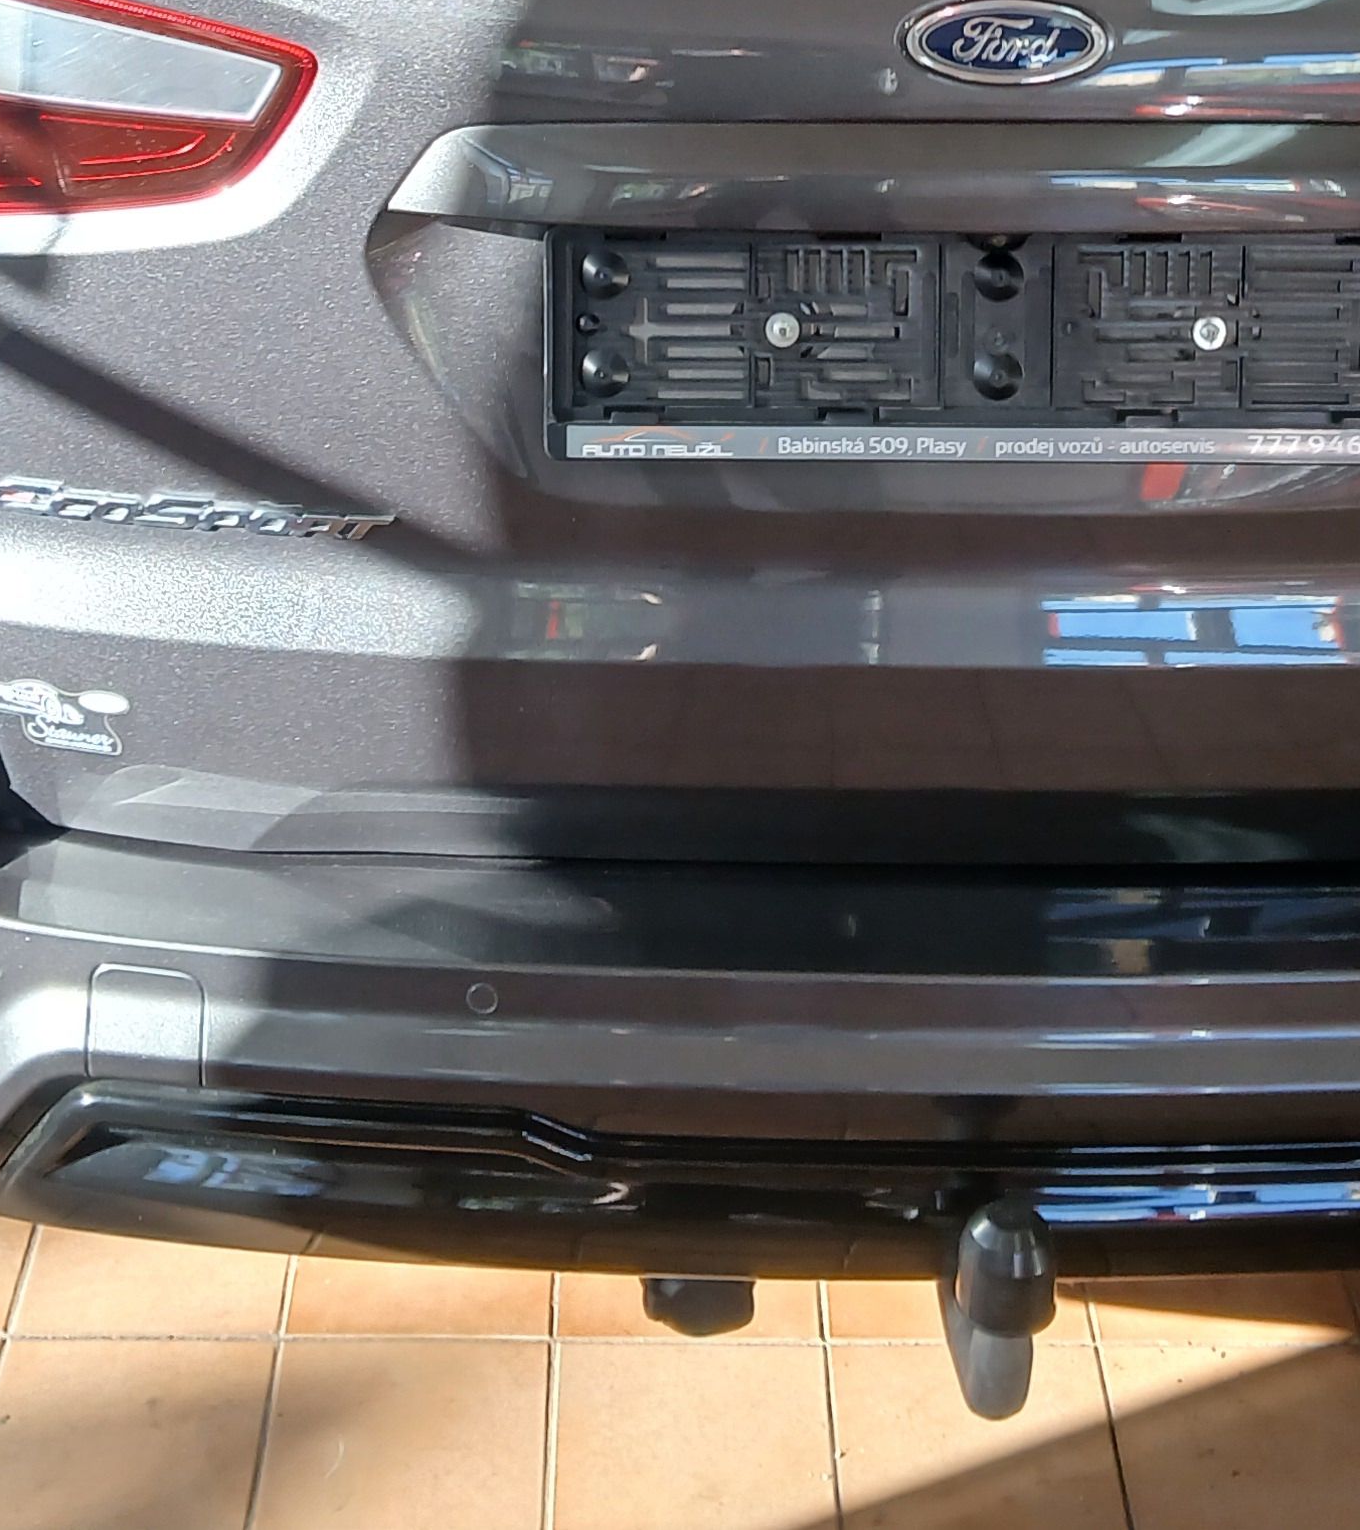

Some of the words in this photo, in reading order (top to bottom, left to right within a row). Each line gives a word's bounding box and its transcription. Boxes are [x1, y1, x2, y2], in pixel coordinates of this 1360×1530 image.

[952, 15, 1060, 64] Ford
[582, 444, 646, 457] AUTO
[777, 436, 865, 455] Babinská
[868, 436, 913, 456] 509,
[916, 436, 967, 458] Plasy
[995, 437, 1054, 458] prodej
[1058, 436, 1104, 455] vozů
[1119, 439, 1216, 455] autoservis
[1247, 434, 1304, 455] 777
